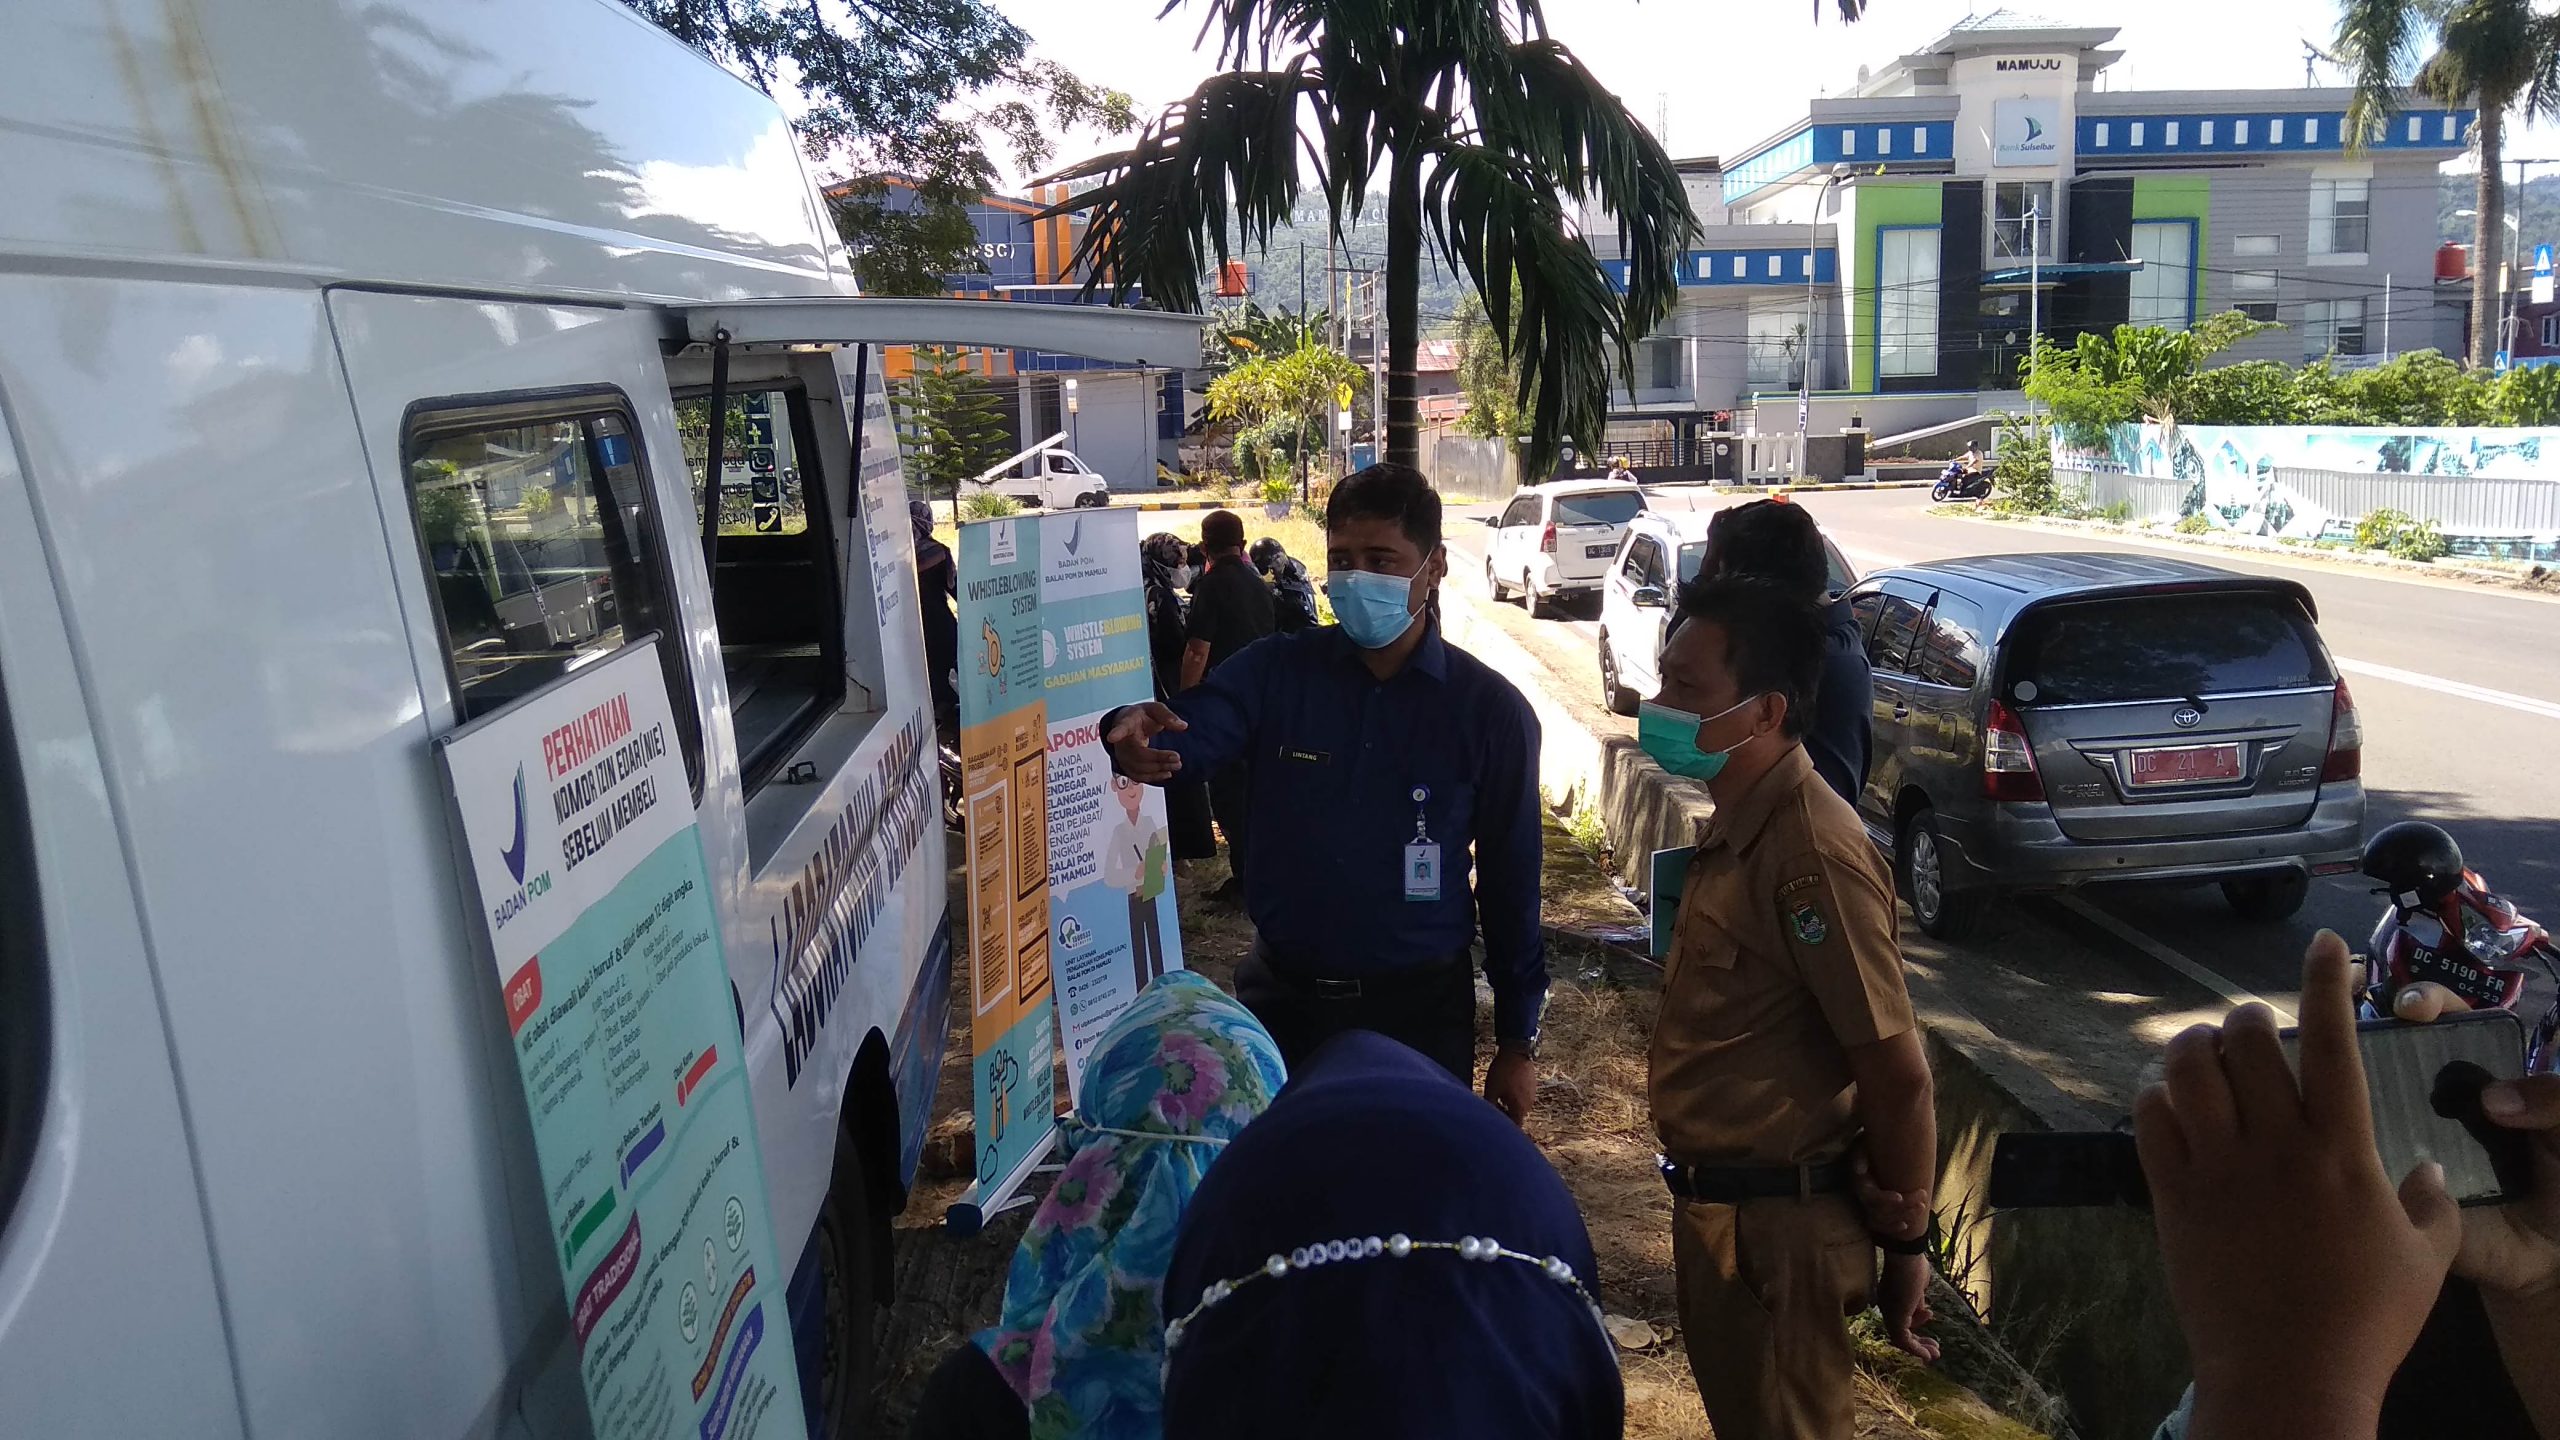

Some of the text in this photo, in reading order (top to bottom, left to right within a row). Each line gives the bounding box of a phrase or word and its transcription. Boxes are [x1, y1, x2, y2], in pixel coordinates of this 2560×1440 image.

[1996, 59, 2061, 72] MAMUJU
[2020, 142, 2056, 152] Sulselbar
[1057, 556, 1095, 569] BADAN POM
[968, 570, 1037, 602] WHISTLEBLOWING
[1045, 573, 1064, 583] BALAI
[1064, 571, 1077, 580] POM
[1084, 567, 1108, 577] MAMUJU
[1011, 593, 1038, 617] SYSTEM
[1066, 638, 1103, 661] SYSTEM
[1043, 656, 1145, 689] GADUAN MASYARAKAT
[542, 692, 632, 782] PERHATIKAN
[1046, 722, 1102, 753] APORKA
[1057, 753, 1082, 769] ANDA
[1076, 762, 1093, 776] DAN
[2137, 750, 2225, 773] DC 21 A
[553, 771, 597, 825] NOMOR
[597, 758, 617, 802] IZIN
[1047, 798, 1100, 823] ECURANGAN
[562, 775, 658, 872] SEBELUM MEMBELI
[1049, 821, 1065, 836] ARI
[1049, 826, 1091, 848] ENGAWAI
[1076, 850, 1095, 866] POM
[1049, 862, 1096, 887] DI MAMUJU
[494, 870, 553, 931] BADAN POM
[691, 927, 709, 948] lokal
[531, 1014, 550, 1042] obat
[548, 987, 578, 1025] diawali
[591, 949, 615, 980] huruf
[613, 945, 623, 963] &
[634, 911, 655, 939] dengan
[653, 901, 662, 919] 12
[672, 877, 693, 901] angka
[1076, 948, 1096, 962] LAYANAN
[2413, 947, 2506, 993] DC 5190 FR
[511, 976, 534, 1013] OBAT
[713, 1139, 731, 1167] huruf
[730, 1133, 740, 1150] &
